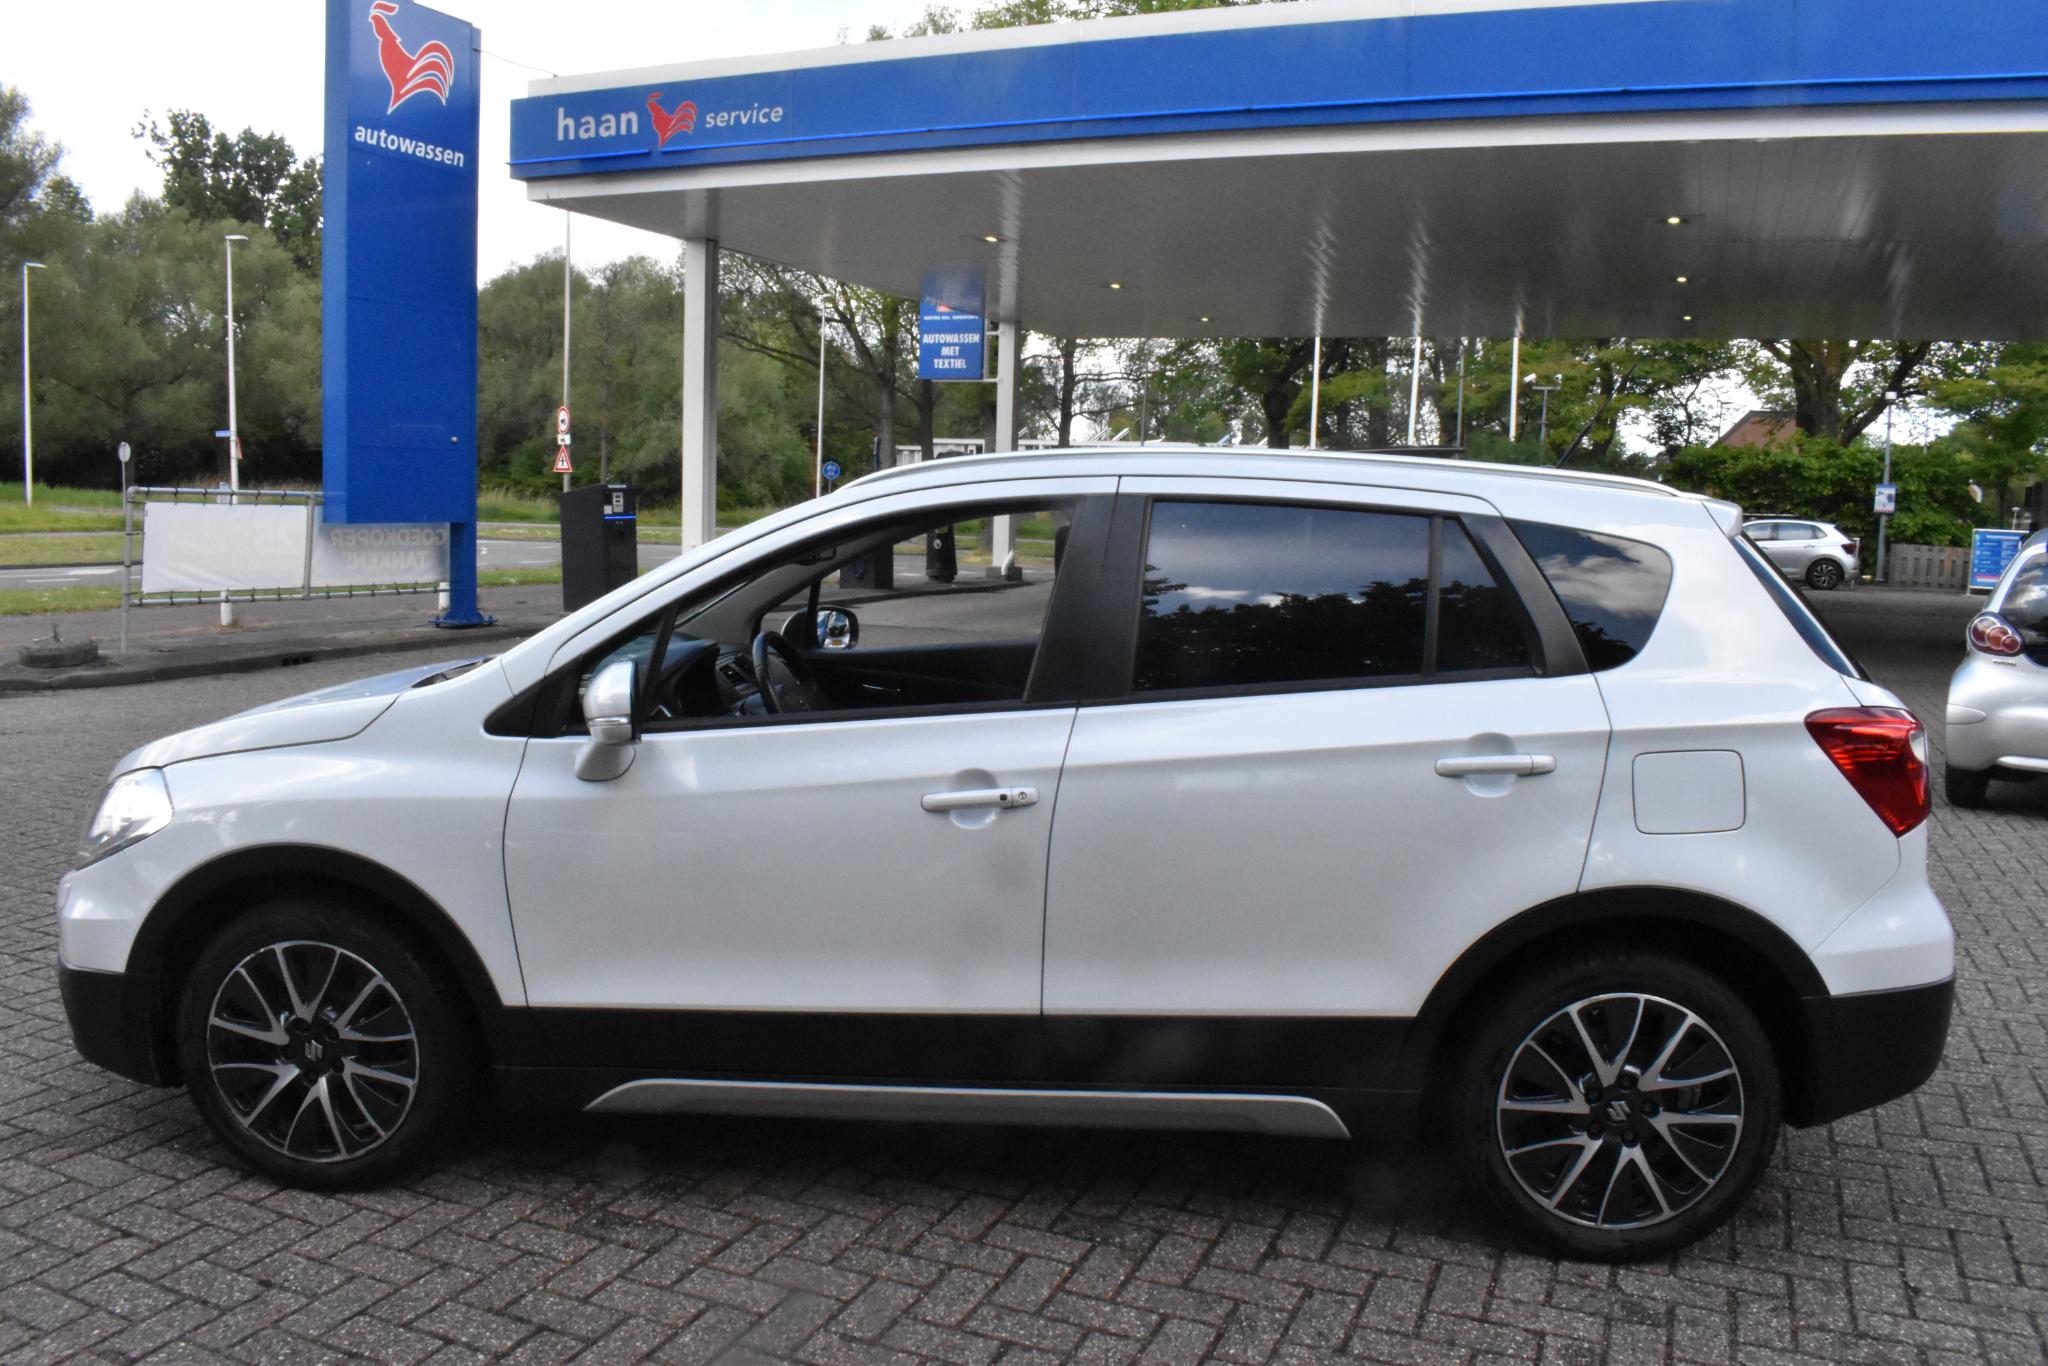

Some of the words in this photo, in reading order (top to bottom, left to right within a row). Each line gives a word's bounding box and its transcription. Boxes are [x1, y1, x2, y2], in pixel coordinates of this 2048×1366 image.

[557, 107, 639, 141] haan
[705, 103, 784, 129] service
[354, 123, 465, 169] autowassen
[922, 333, 980, 343] AUTOWASSEN
[941, 346, 960, 356] MET
[933, 358, 967, 369] TEXTIEL
